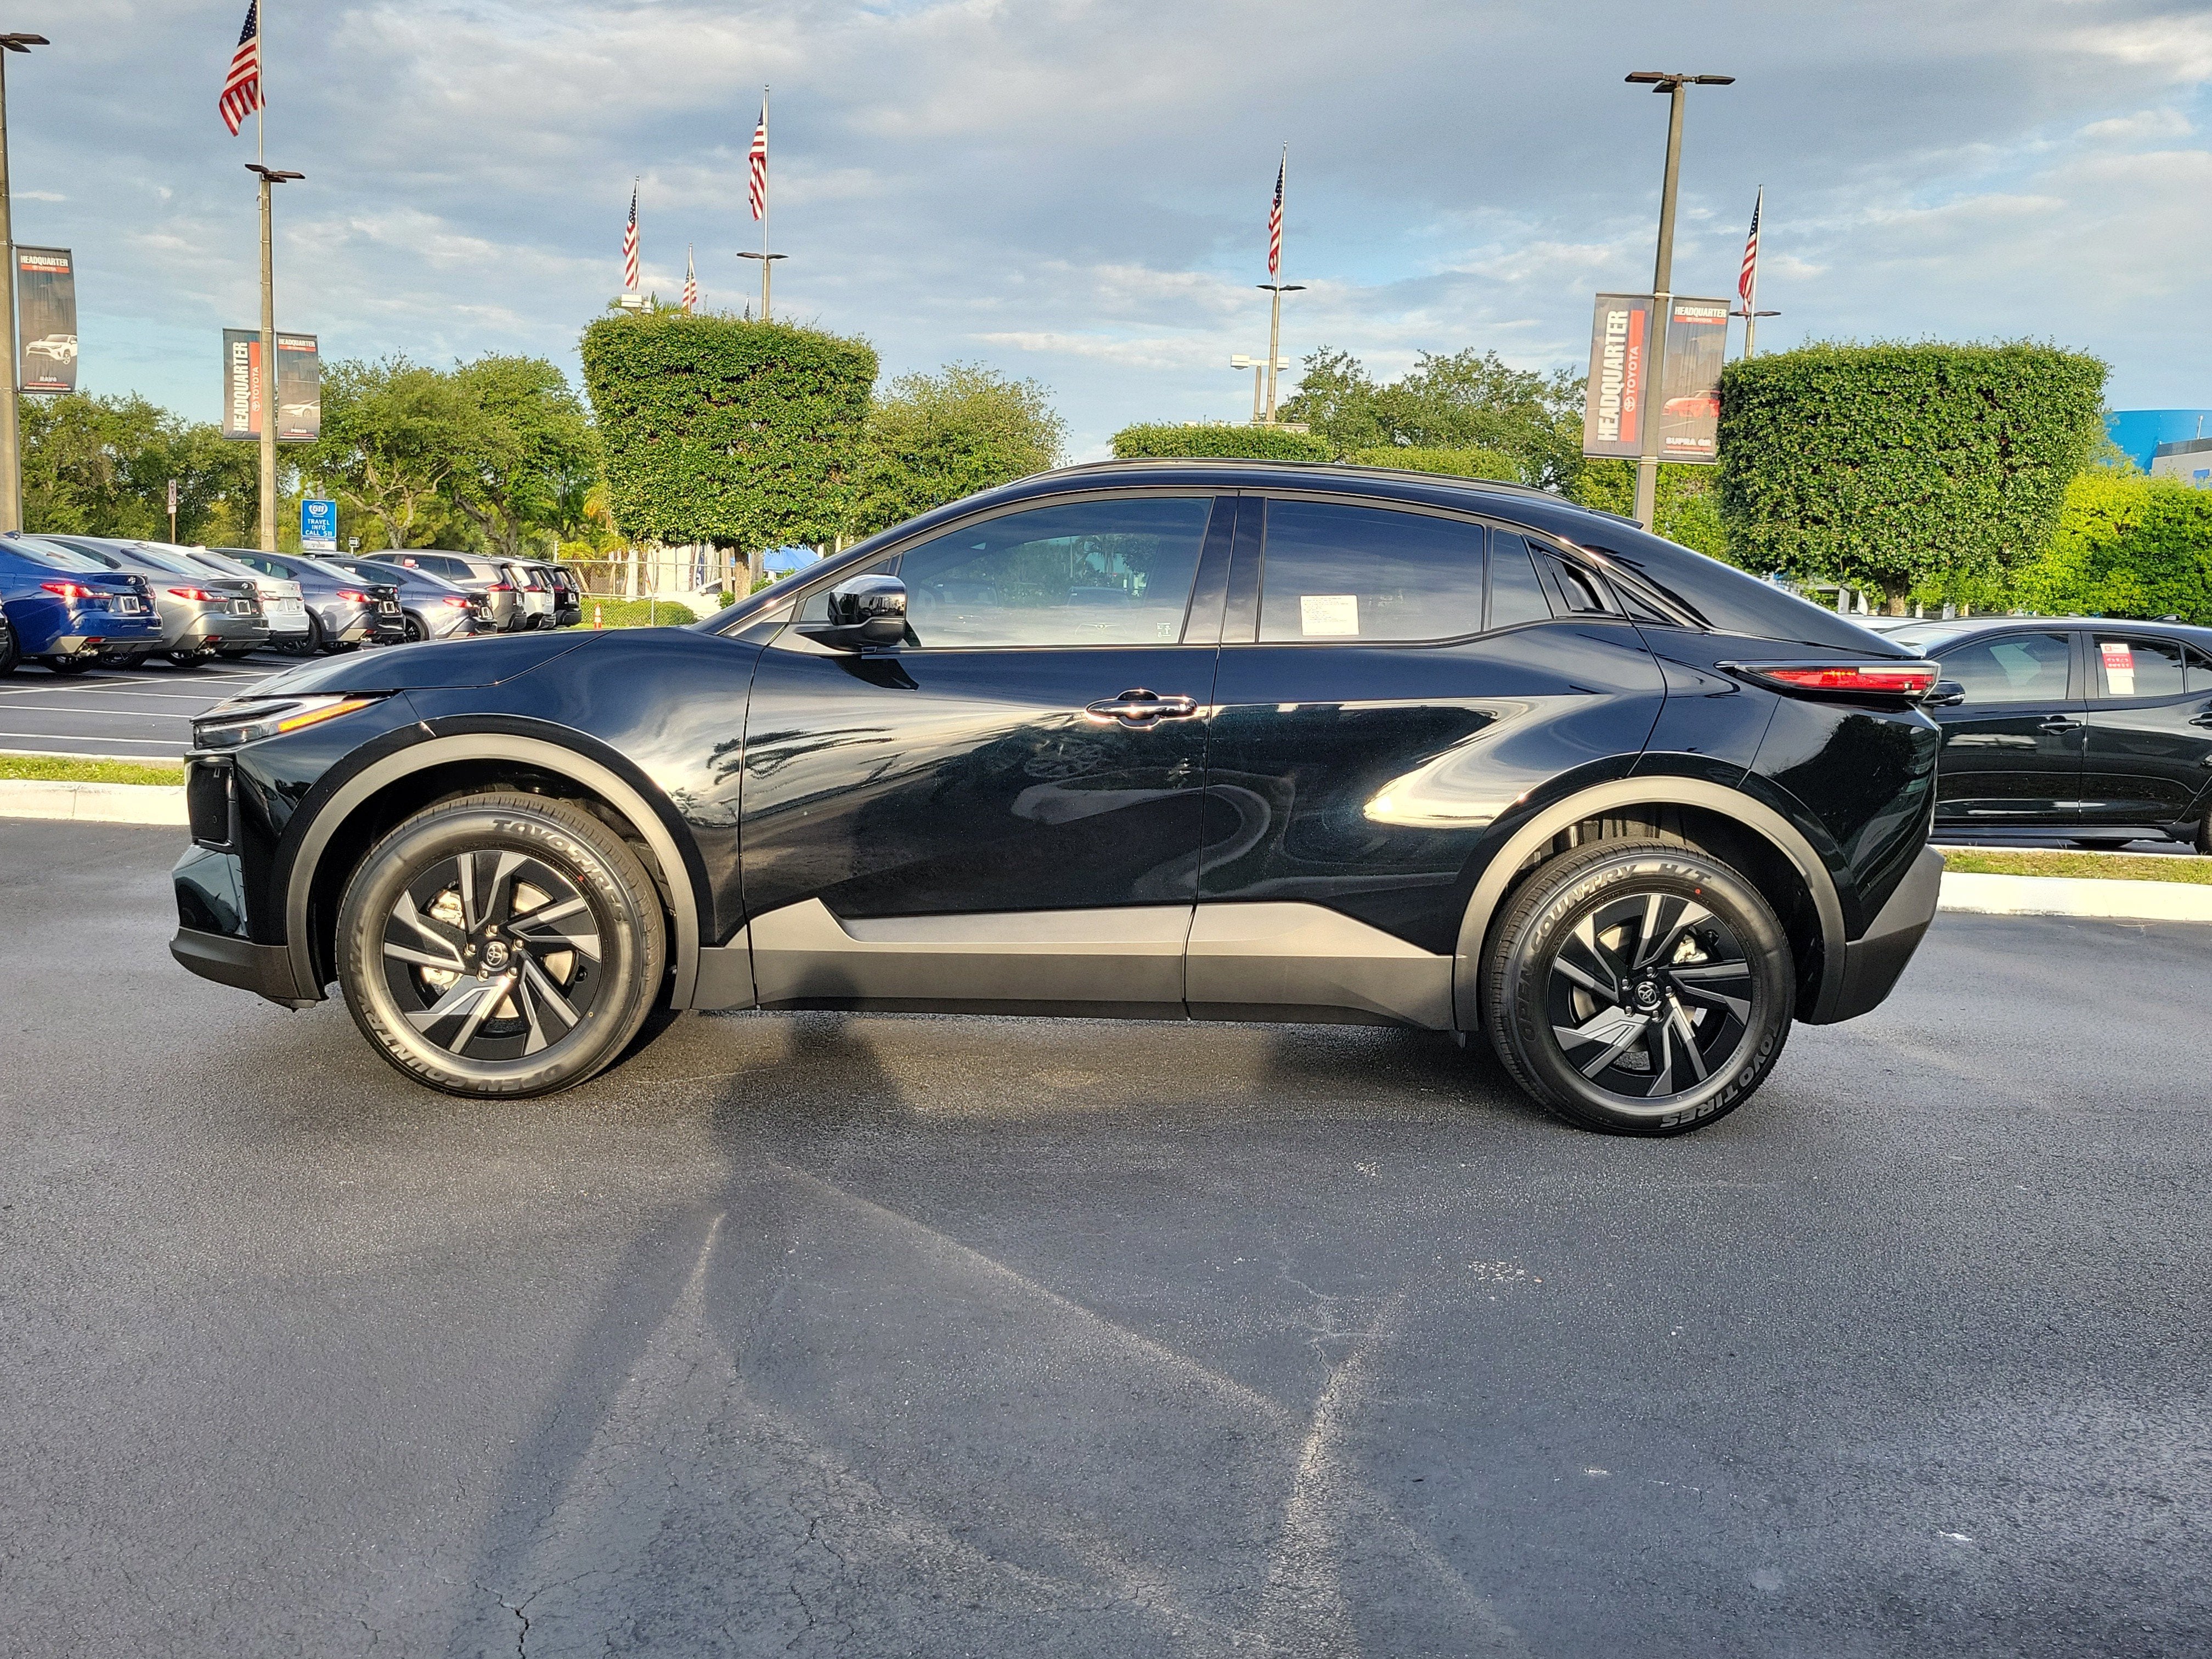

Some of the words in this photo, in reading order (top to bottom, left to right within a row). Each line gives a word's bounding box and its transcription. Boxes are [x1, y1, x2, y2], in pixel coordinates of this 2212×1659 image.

[20, 255, 69, 267] HEADQUARTER
[1674, 306, 1726, 318] HEADQUARTER
[278, 338, 315, 347] HEADQUARTER
[233, 342, 251, 432] HEADQUARTER
[1597, 311, 1628, 442] HEADQUARTER
[1626, 346, 1639, 396] TOYOTA
[1666, 437, 1696, 445] SUPRA
[493, 819, 571, 851] TOYO
[1530, 865, 1638, 953] COUNTRY
[1657, 863, 1712, 883] H/T
[358, 995, 467, 1089] COUNTRY
[1739, 1020, 1780, 1087] TOYO
[478, 1065, 564, 1091] OPEN
[1660, 1085, 1739, 1127] TIRES
